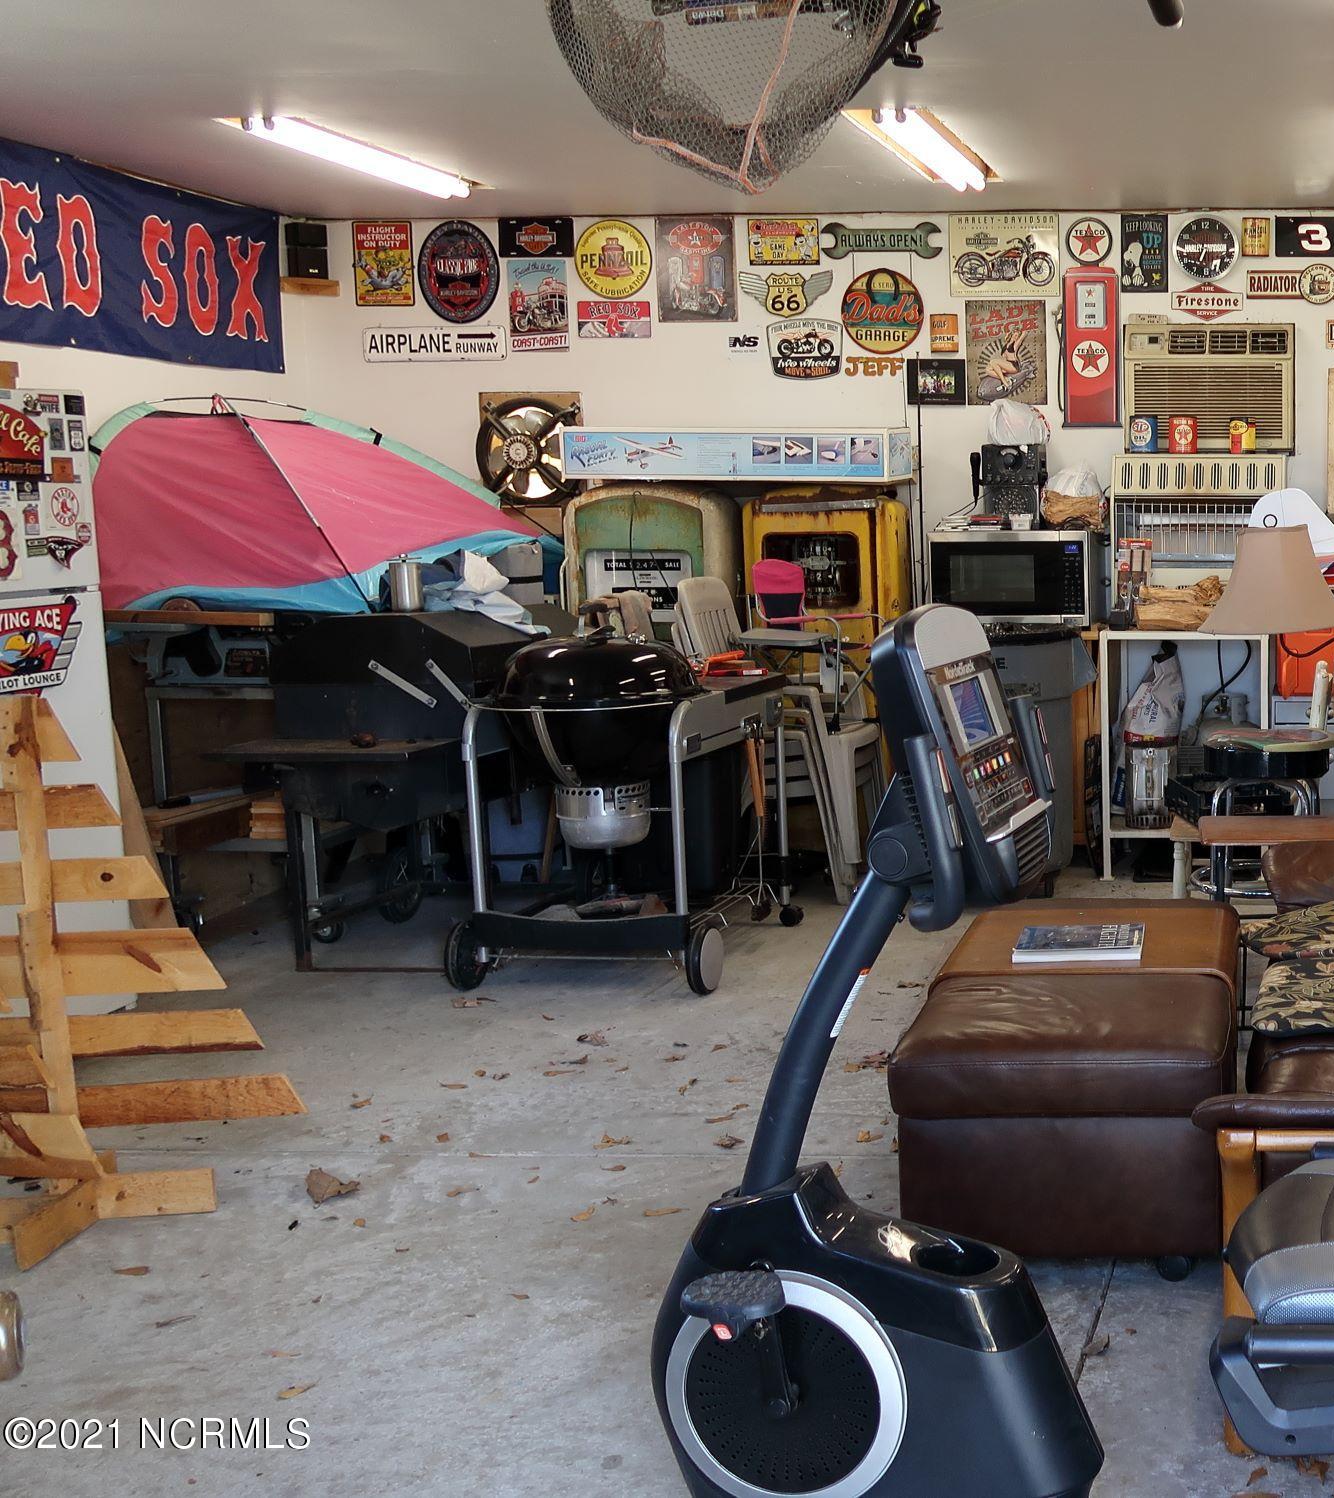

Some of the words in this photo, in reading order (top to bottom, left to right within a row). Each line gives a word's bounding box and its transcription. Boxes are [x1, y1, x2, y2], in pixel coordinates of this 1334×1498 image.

[367, 226, 396, 234] FLIGHT
[1125, 222, 1139, 233] KEEP
[1139, 220, 1163, 233] LOOKING
[840, 235, 887, 249] ALWAYS
[889, 234, 923, 248] OPEN!
[1142, 233, 1162, 249] UP
[1297, 222, 1332, 252] 3
[769, 243, 786, 251] GAME
[772, 251, 784, 259] DAY
[580, 250, 647, 269] PENNZOIL
[141, 215, 269, 342] SOX
[1303, 265, 1327, 279] WELCOME
[582, 269, 598, 290] SAFE
[600, 268, 646, 296] LUBRICATION
[771, 276, 800, 285] ROUTE
[1249, 276, 1297, 293] RADIATOR
[771, 294, 800, 312] 66
[842, 291, 924, 325] Dad's
[1175, 295, 1239, 307] Firestone
[587, 303, 611, 318] RED
[616, 303, 641, 318] SOX
[969, 304, 1039, 326] LADY
[855, 329, 909, 342] GARAGE
[970, 317, 1039, 340] LUCK
[368, 334, 452, 353] AIRPLANE
[456, 342, 498, 353] RUNWAY
[512, 338, 536, 348] COAST
[539, 335, 567, 347] COAST!
[729, 334, 760, 347] NS
[784, 367, 805, 377] MOVE
[844, 356, 905, 377] JEFF
[1133, 422, 1149, 432] STP
[10, 418, 41, 456] Cafe
[35, 608, 62, 631] ACE
[944, 659, 976, 681] NordicTrack
[0, 678, 20, 690] LOT
[23, 672, 62, 686] LOUNGE
